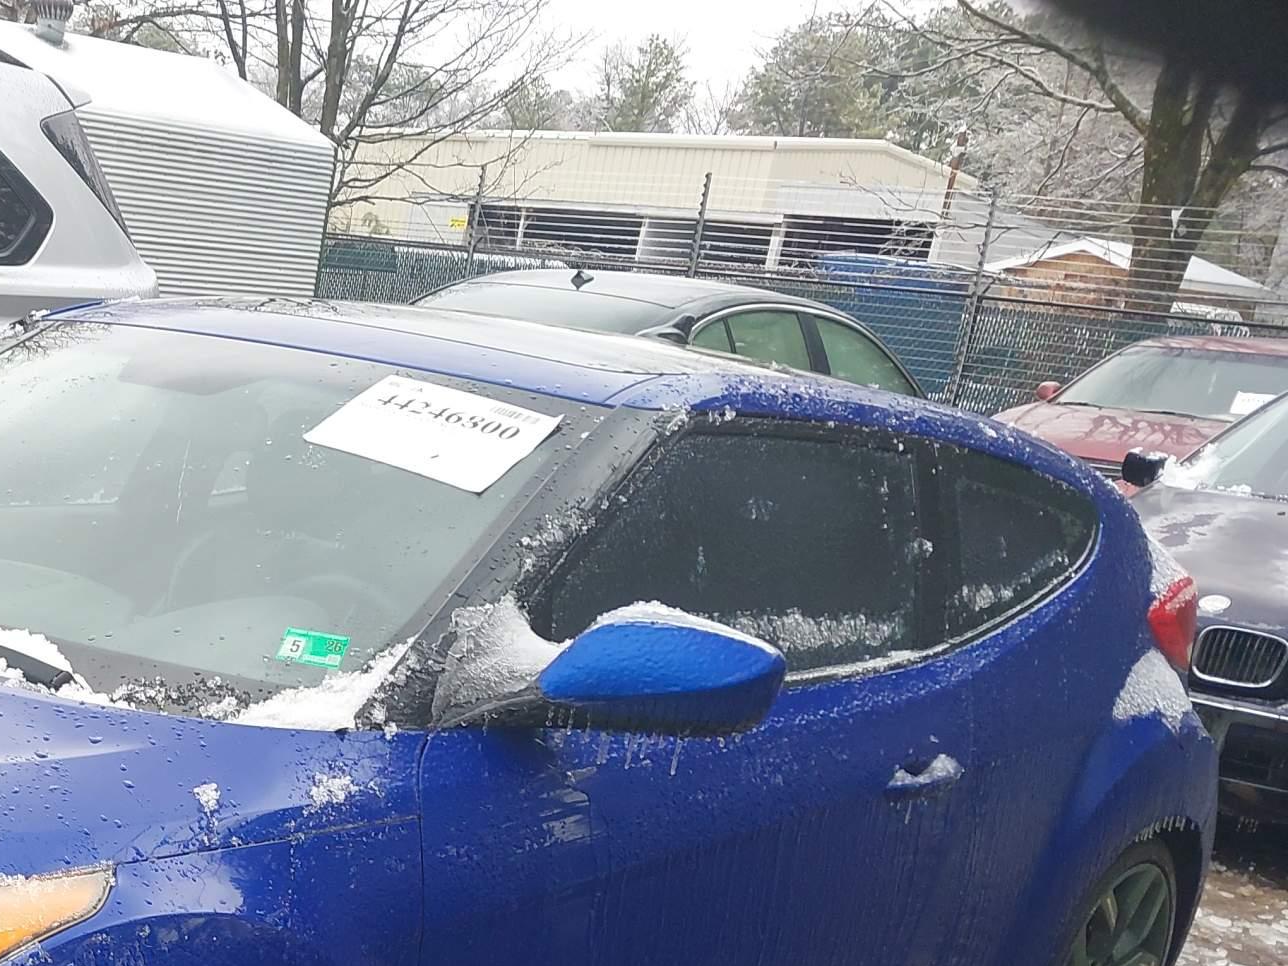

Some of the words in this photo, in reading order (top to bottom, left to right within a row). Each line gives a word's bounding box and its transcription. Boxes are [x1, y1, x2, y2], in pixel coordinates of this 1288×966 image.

[377, 394, 520, 440] 44246800
[289, 639, 302, 653] 5
[326, 640, 342, 653] 26
